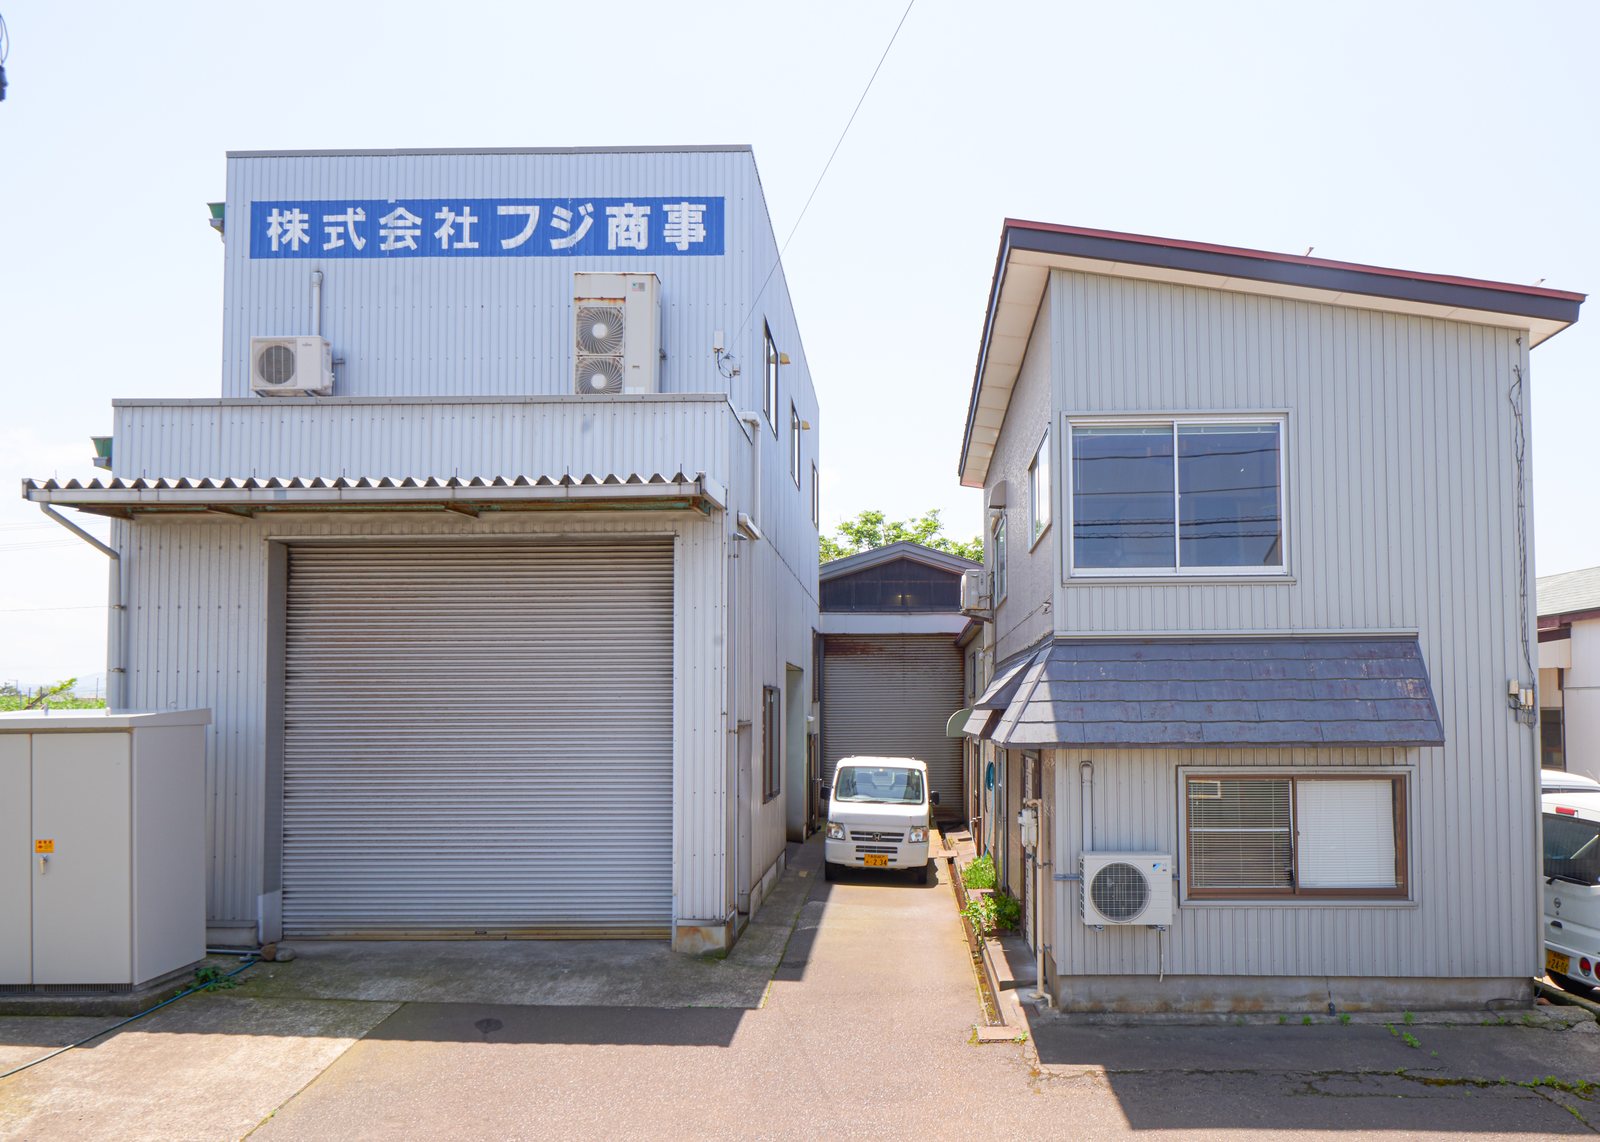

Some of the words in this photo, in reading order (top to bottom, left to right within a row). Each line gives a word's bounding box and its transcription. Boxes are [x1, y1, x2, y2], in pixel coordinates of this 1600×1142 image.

[266, 201, 707, 252] 株式会社フジ商事
